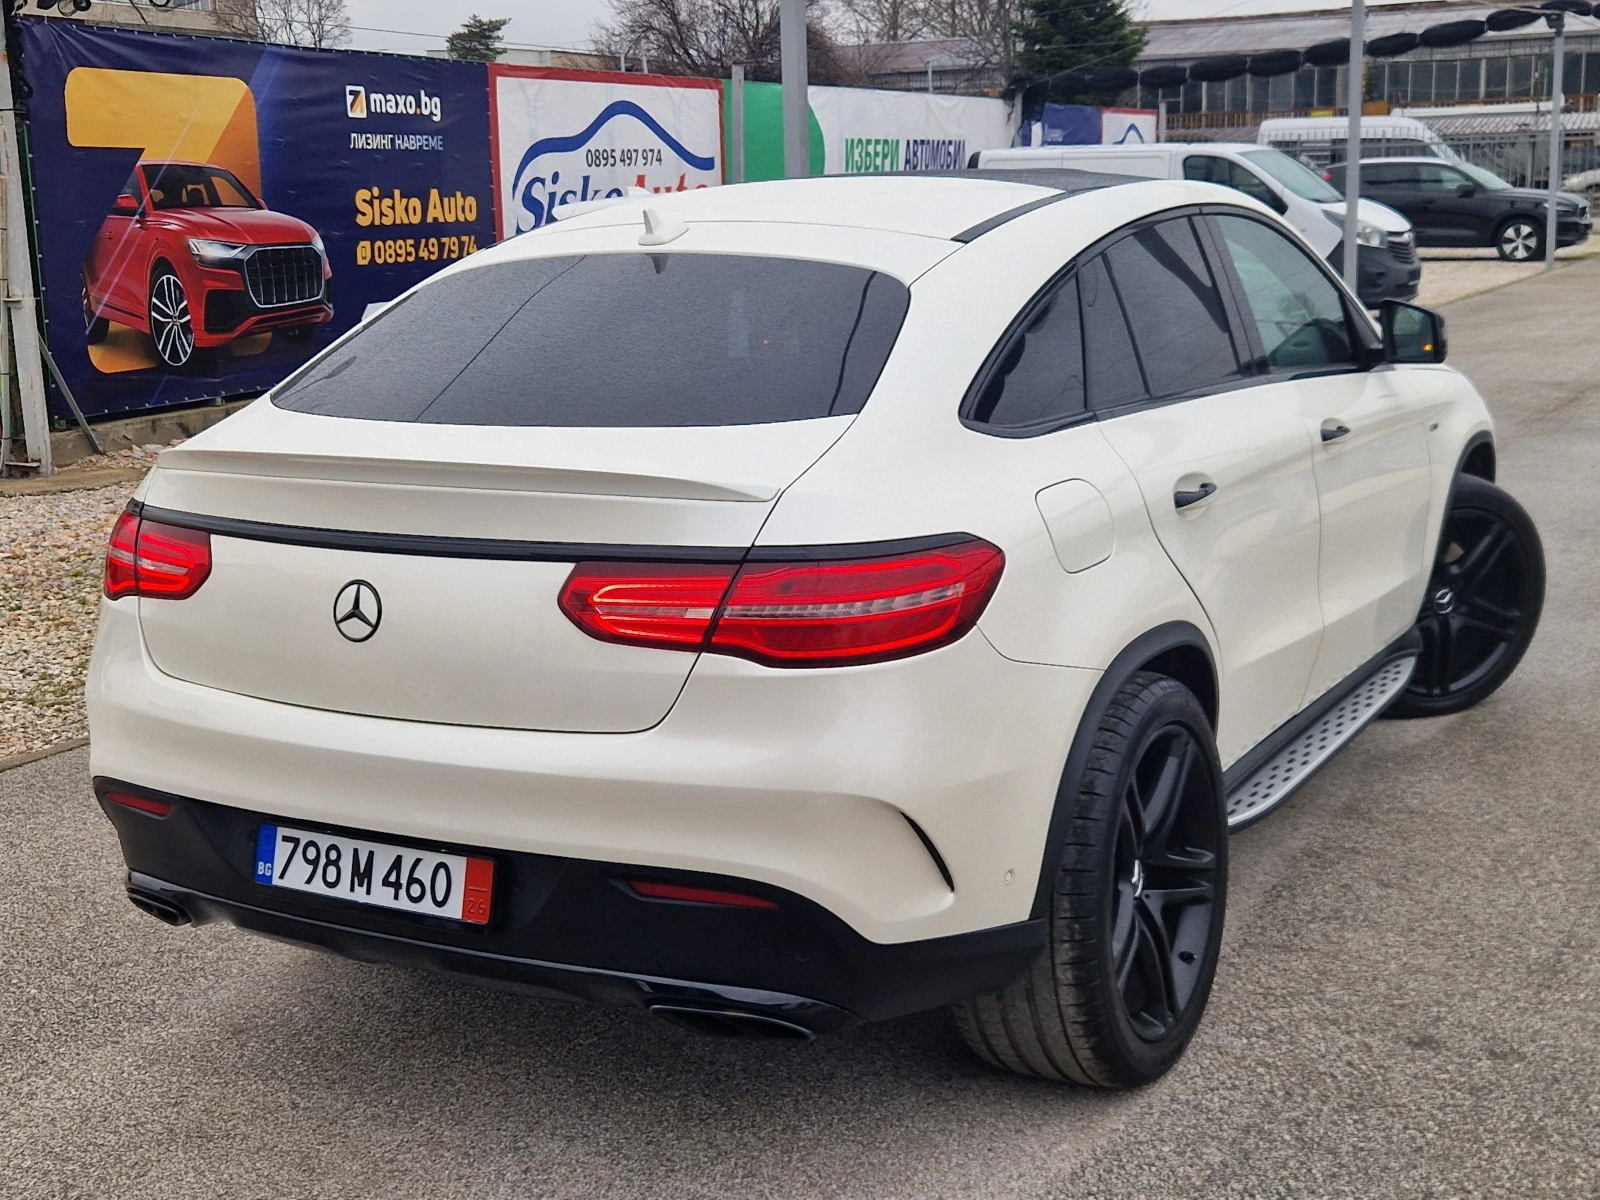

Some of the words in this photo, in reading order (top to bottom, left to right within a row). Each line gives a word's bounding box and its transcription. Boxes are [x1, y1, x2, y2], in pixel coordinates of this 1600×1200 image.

[369, 89, 441, 122] maxo.bg
[350, 133, 393, 150] ЛИЗИНГ
[395, 135, 443, 151] НАВРЕМЕ
[586, 148, 617, 168] 0895
[619, 148, 639, 167] 497
[641, 148, 662, 167] 974
[844, 138, 900, 172] ИЗБЕРИ
[903, 139, 966, 171] АВТОМОБИЛ
[355, 186, 422, 227] Sisko
[426, 188, 477, 224] Auto
[374, 239, 416, 264] 0895
[418, 237, 439, 261] 49
[440, 236, 460, 260] 79
[460, 235, 478, 257] 74
[257, 861, 272, 876] BG
[467, 897, 486, 914] 26
